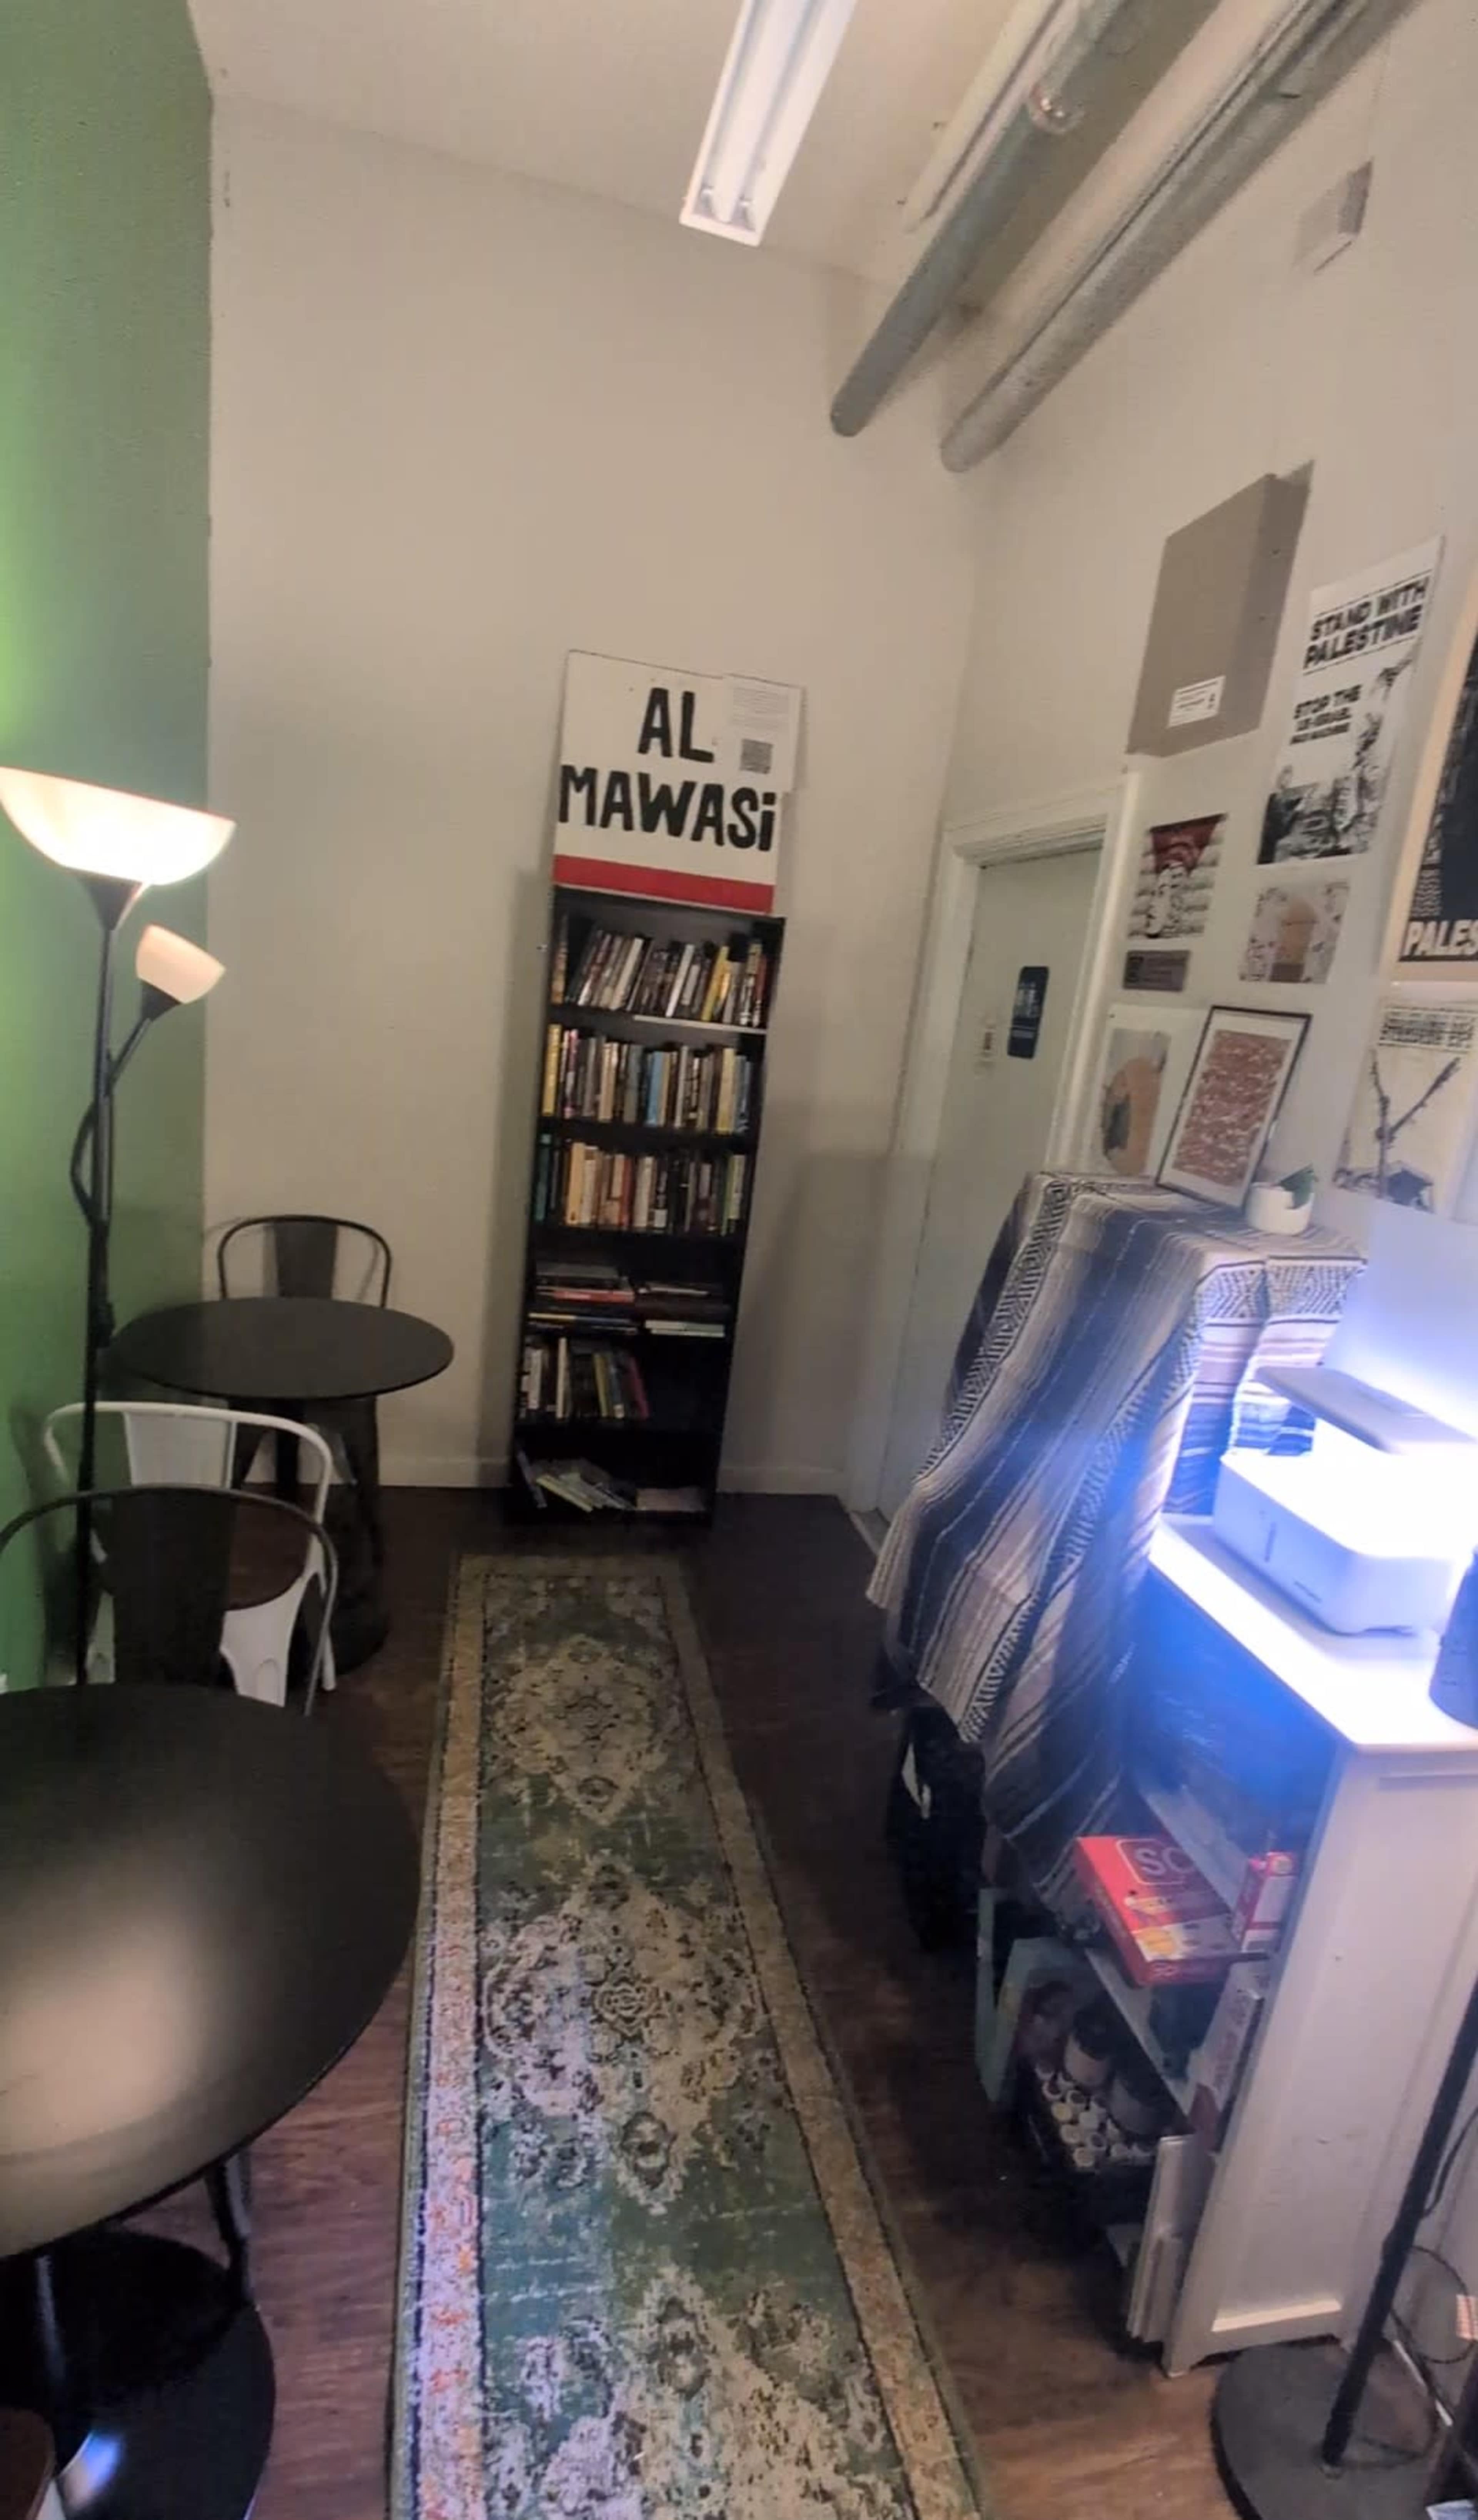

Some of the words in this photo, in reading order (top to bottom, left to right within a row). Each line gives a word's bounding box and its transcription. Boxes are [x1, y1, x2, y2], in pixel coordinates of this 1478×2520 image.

[1303, 604, 1423, 670] PALESTINE
[1311, 601, 1371, 641] STAND
[637, 687, 714, 763] AL
